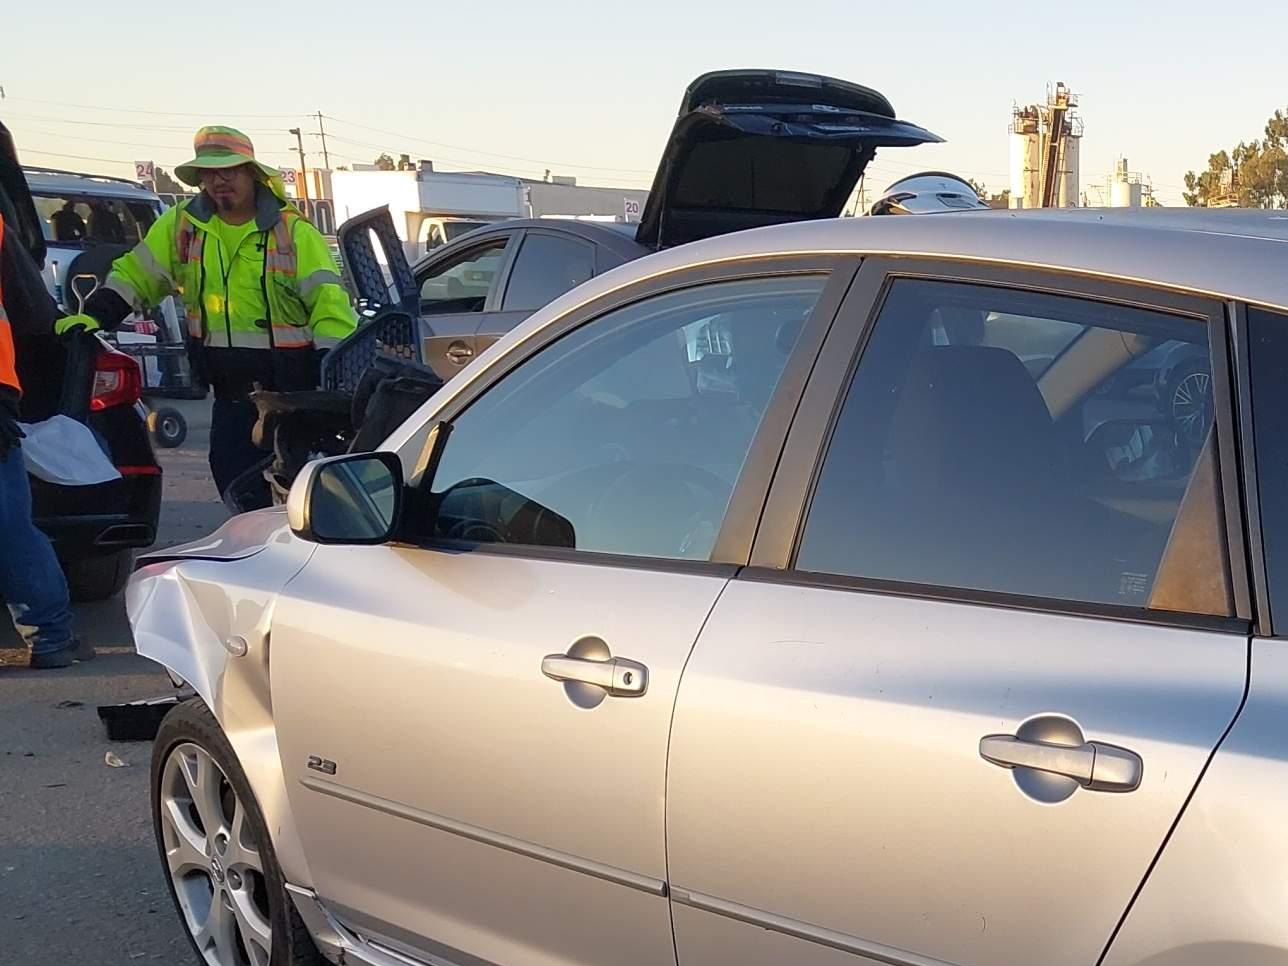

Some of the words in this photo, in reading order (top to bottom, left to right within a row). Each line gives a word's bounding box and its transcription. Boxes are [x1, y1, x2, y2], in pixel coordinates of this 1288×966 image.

[136, 164, 153, 178] 24
[280, 170, 296, 183] 23
[625, 201, 639, 214] 20
